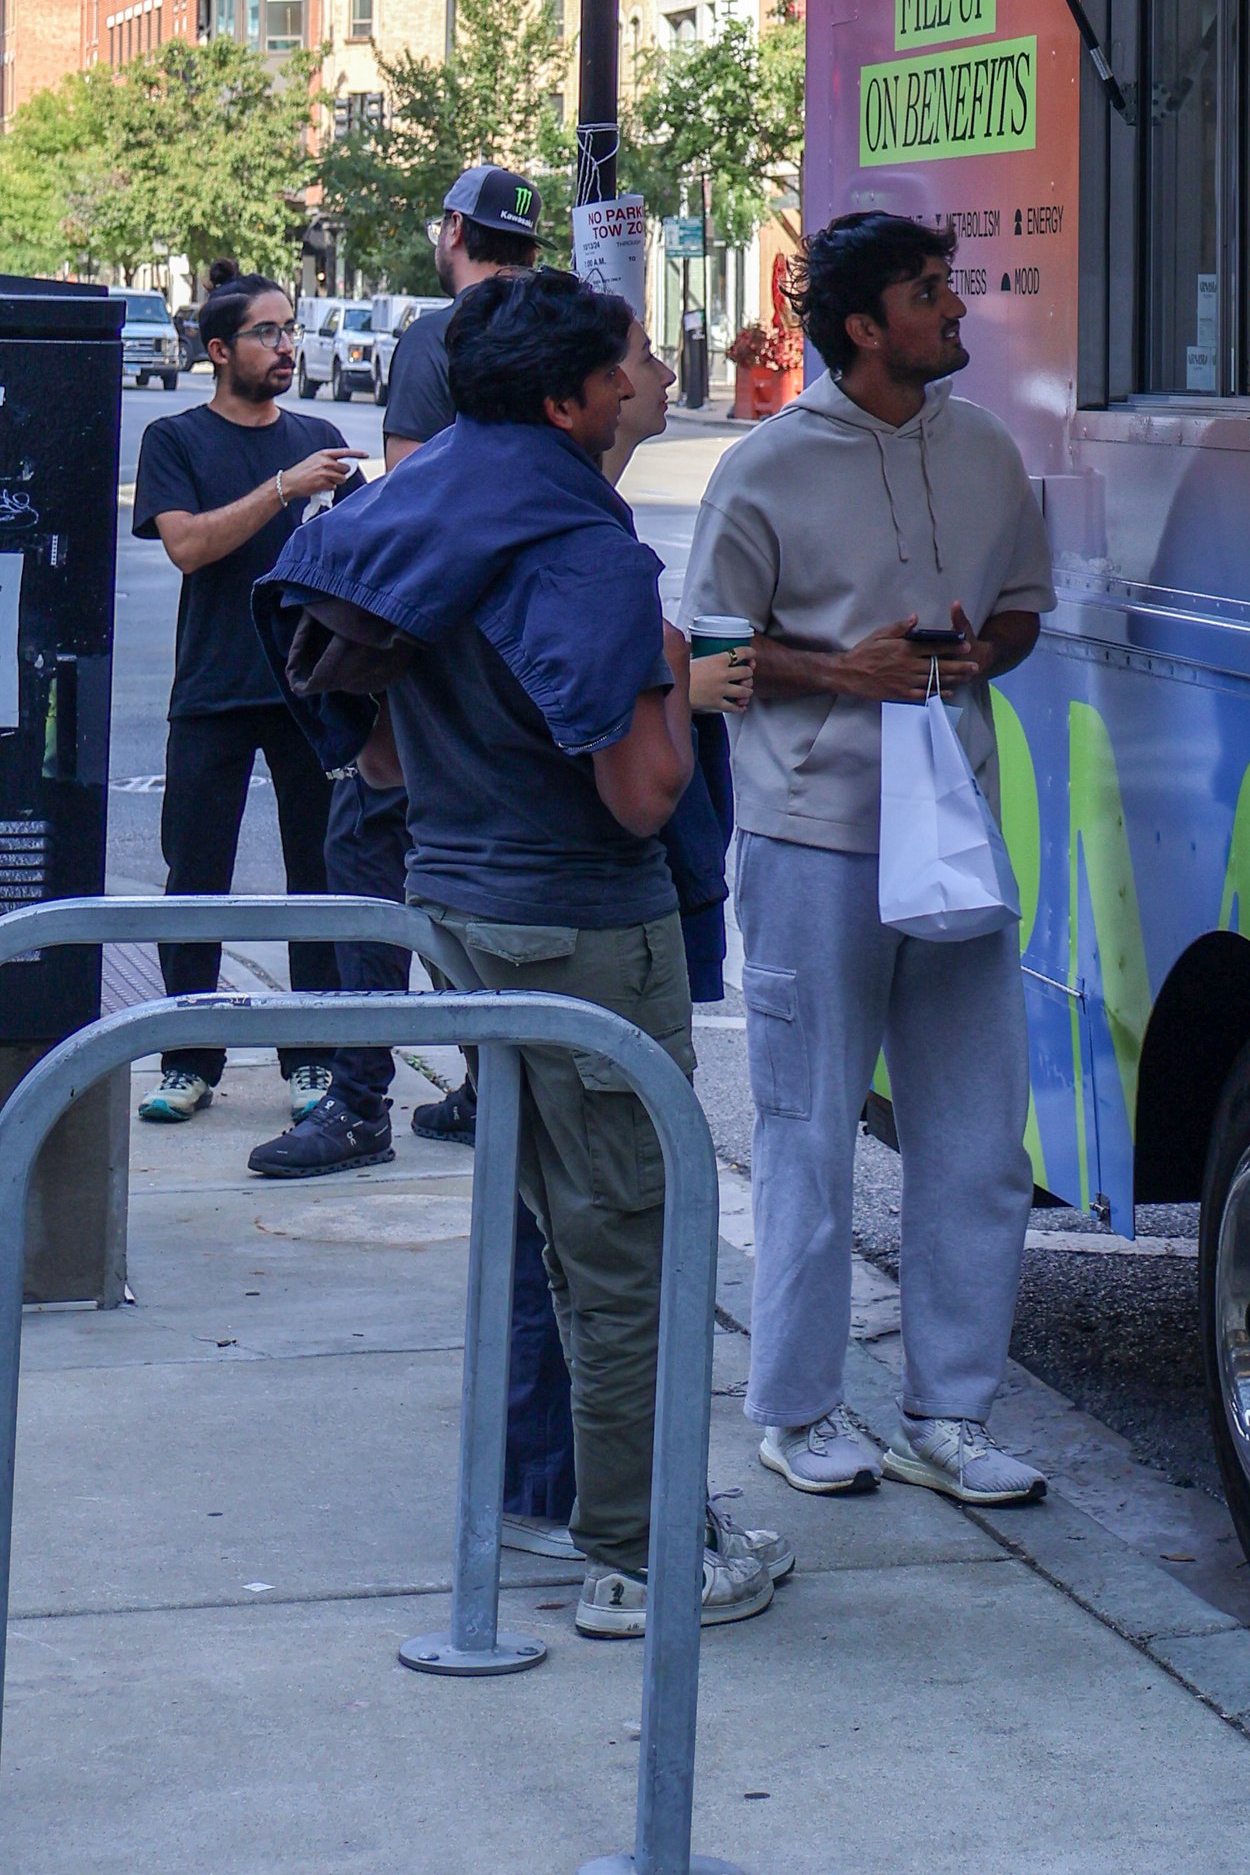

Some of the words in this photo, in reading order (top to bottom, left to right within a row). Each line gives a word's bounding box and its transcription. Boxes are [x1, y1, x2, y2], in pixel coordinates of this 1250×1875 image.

[865, 75, 900, 152] ON
[902, 52, 1031, 148] BENEFITS
[588, 211, 602, 226] NO
[593, 224, 622, 240] TOW
[1027, 205, 1064, 235] ENERGY
[1014, 268, 1039, 295] MOOD
